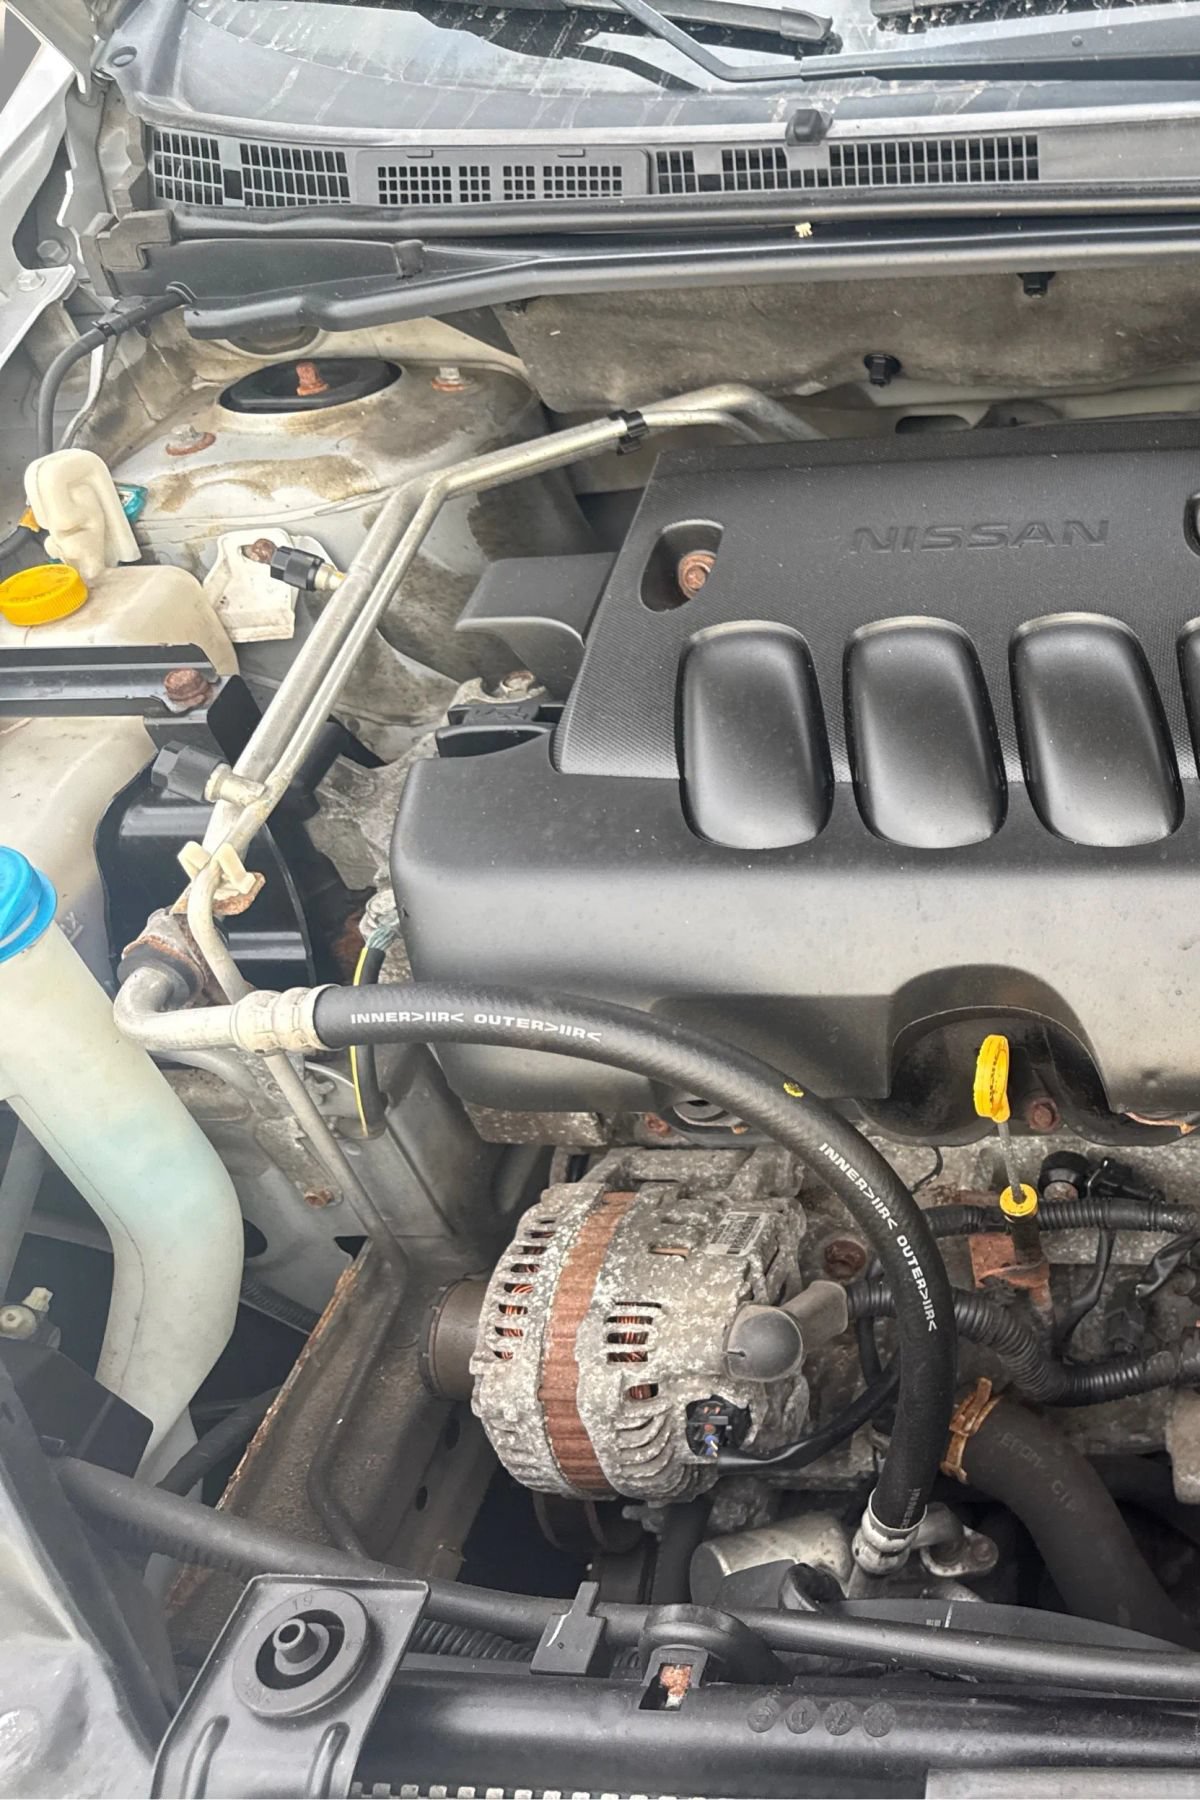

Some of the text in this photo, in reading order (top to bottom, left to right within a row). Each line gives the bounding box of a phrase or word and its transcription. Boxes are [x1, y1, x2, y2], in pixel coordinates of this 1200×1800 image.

[849, 520, 1109, 553] NISSAN
[351, 1012, 602, 1043] INNER>IIR< OUTER>IIR<
[818, 1142, 938, 1332] INNER>IIR< OUTER>IIR<
